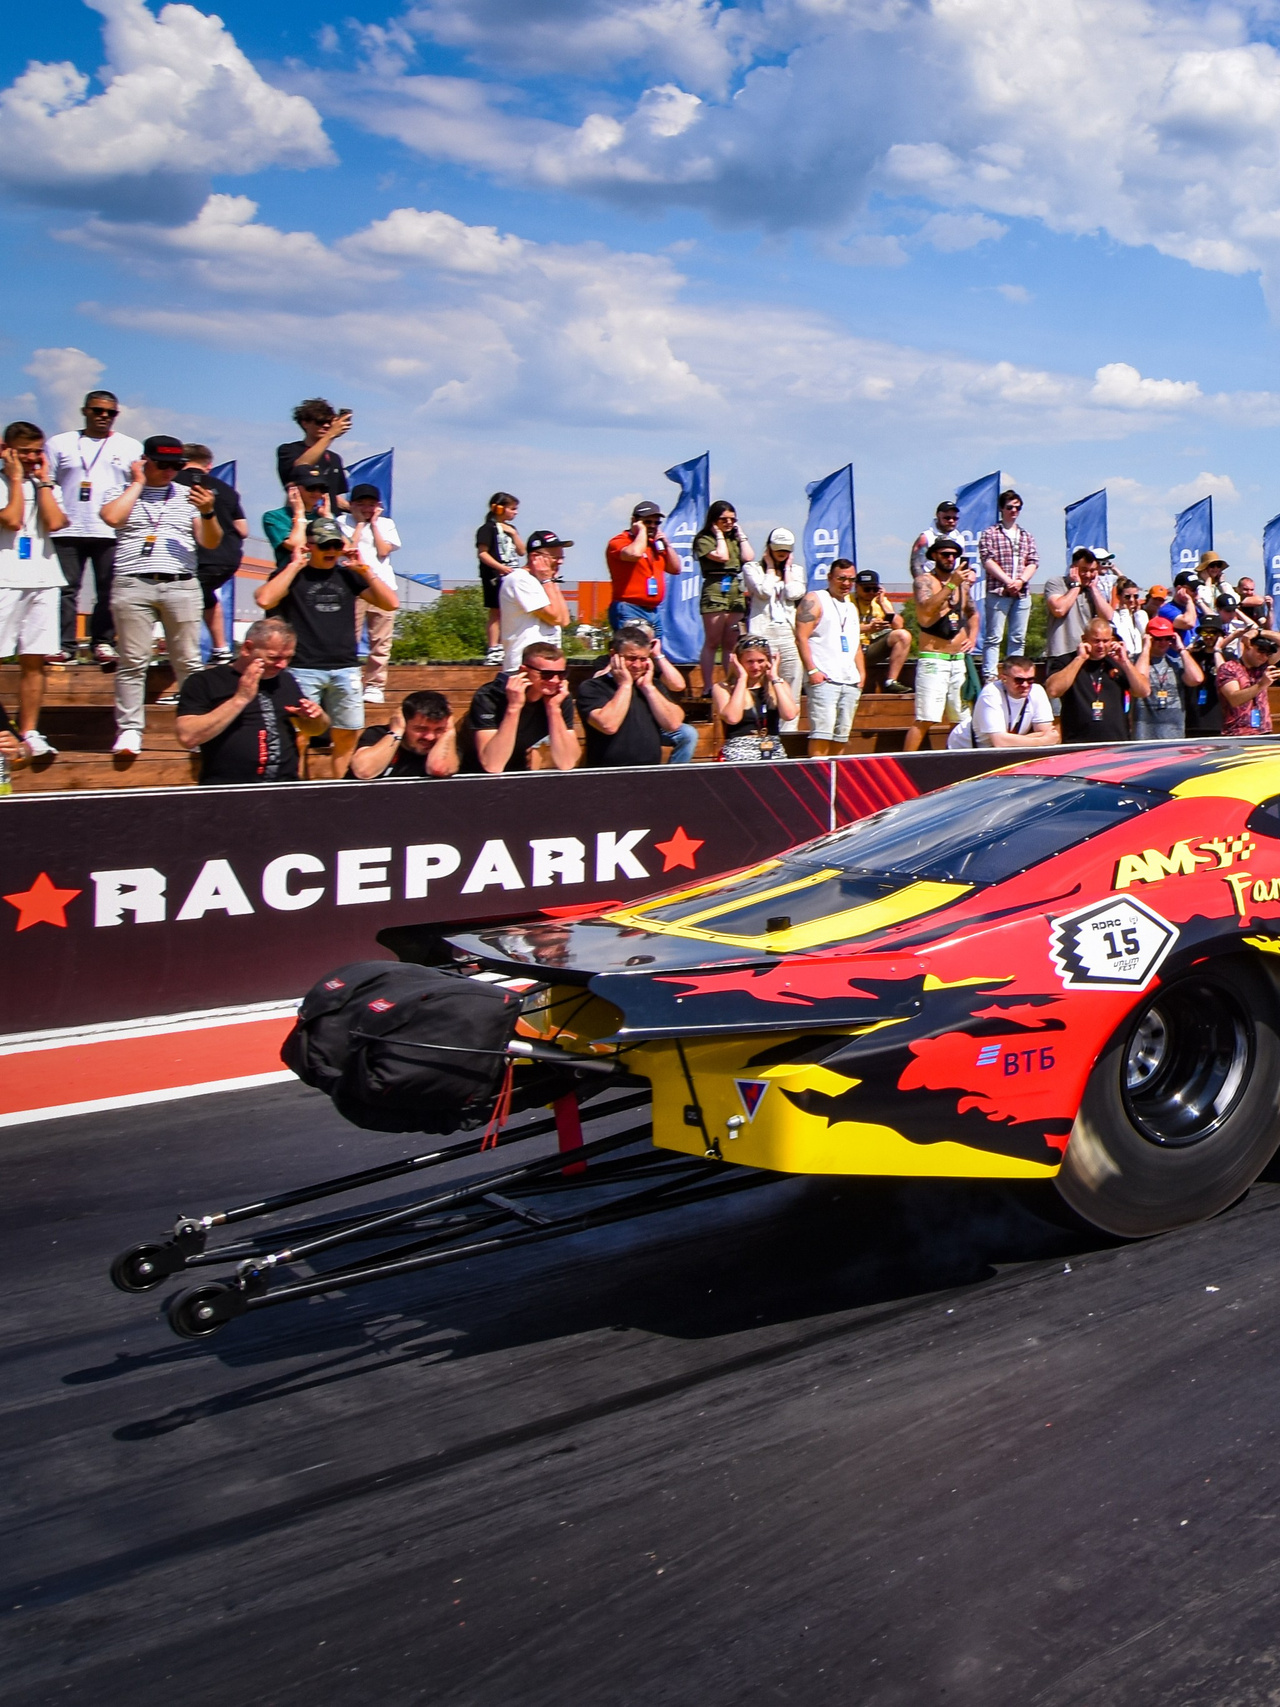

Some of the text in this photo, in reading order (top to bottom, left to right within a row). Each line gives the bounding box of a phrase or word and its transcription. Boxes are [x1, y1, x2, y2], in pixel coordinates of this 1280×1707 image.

[90, 828, 651, 929] RACEPARK
[1091, 919, 1122, 931] RDRC
[1103, 927, 1140, 960] 15
[1004, 1046, 1055, 1077] ВТБ
